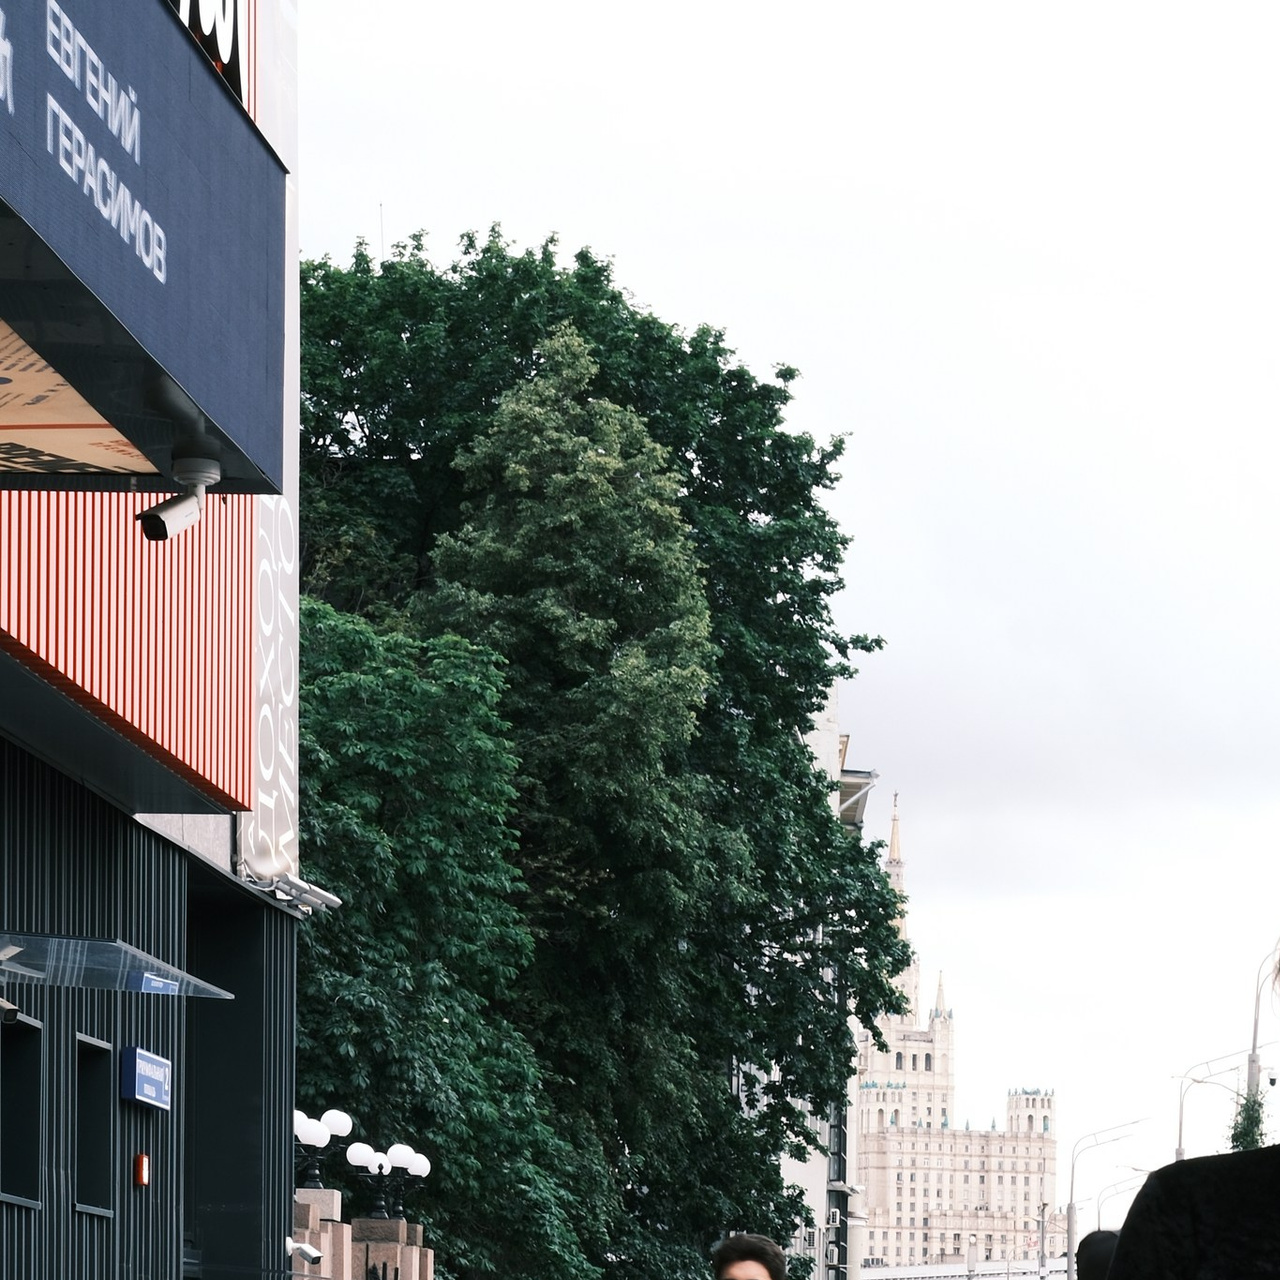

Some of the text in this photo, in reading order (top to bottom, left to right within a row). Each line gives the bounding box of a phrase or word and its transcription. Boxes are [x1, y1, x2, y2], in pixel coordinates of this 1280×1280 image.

[46, 0, 141, 167] ЕВГЕНИЙ
[46, 92, 167, 285] ГЕРАСИМОВ
[278, 496, 295, 876] МЕСТО
